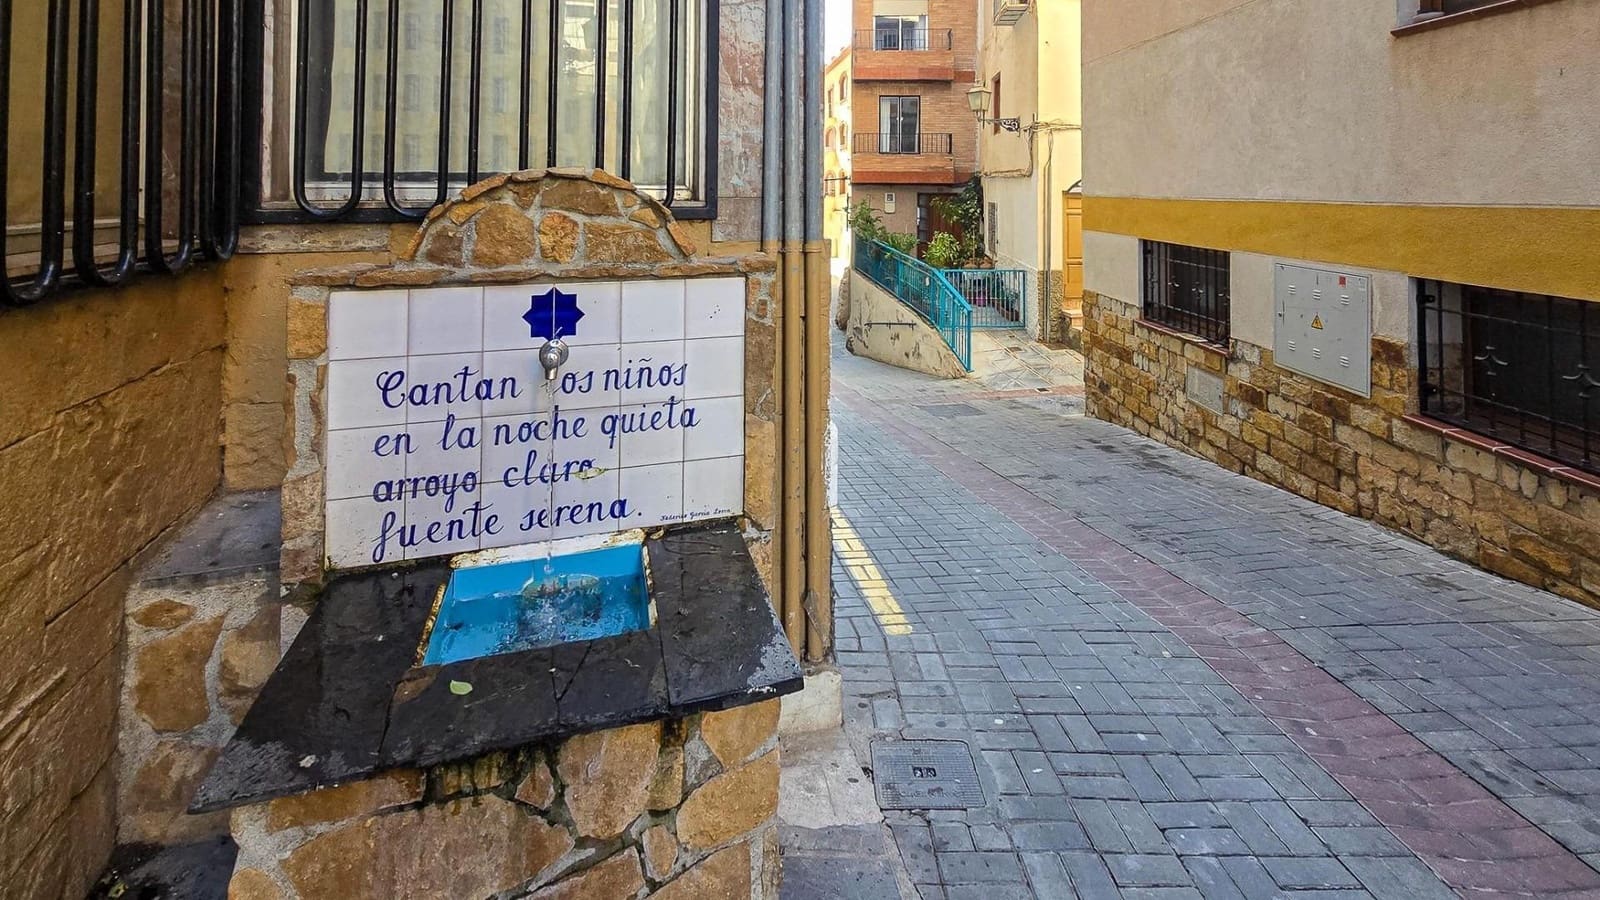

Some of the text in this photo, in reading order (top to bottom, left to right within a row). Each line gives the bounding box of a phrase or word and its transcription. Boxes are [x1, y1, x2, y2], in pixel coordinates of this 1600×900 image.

[376, 364, 522, 409] Cantan
[602, 357, 689, 392] niños
[371, 395, 702, 458] en la noche quieta
[372, 449, 596, 514] arroyo claro
[371, 501, 504, 564] fuente
